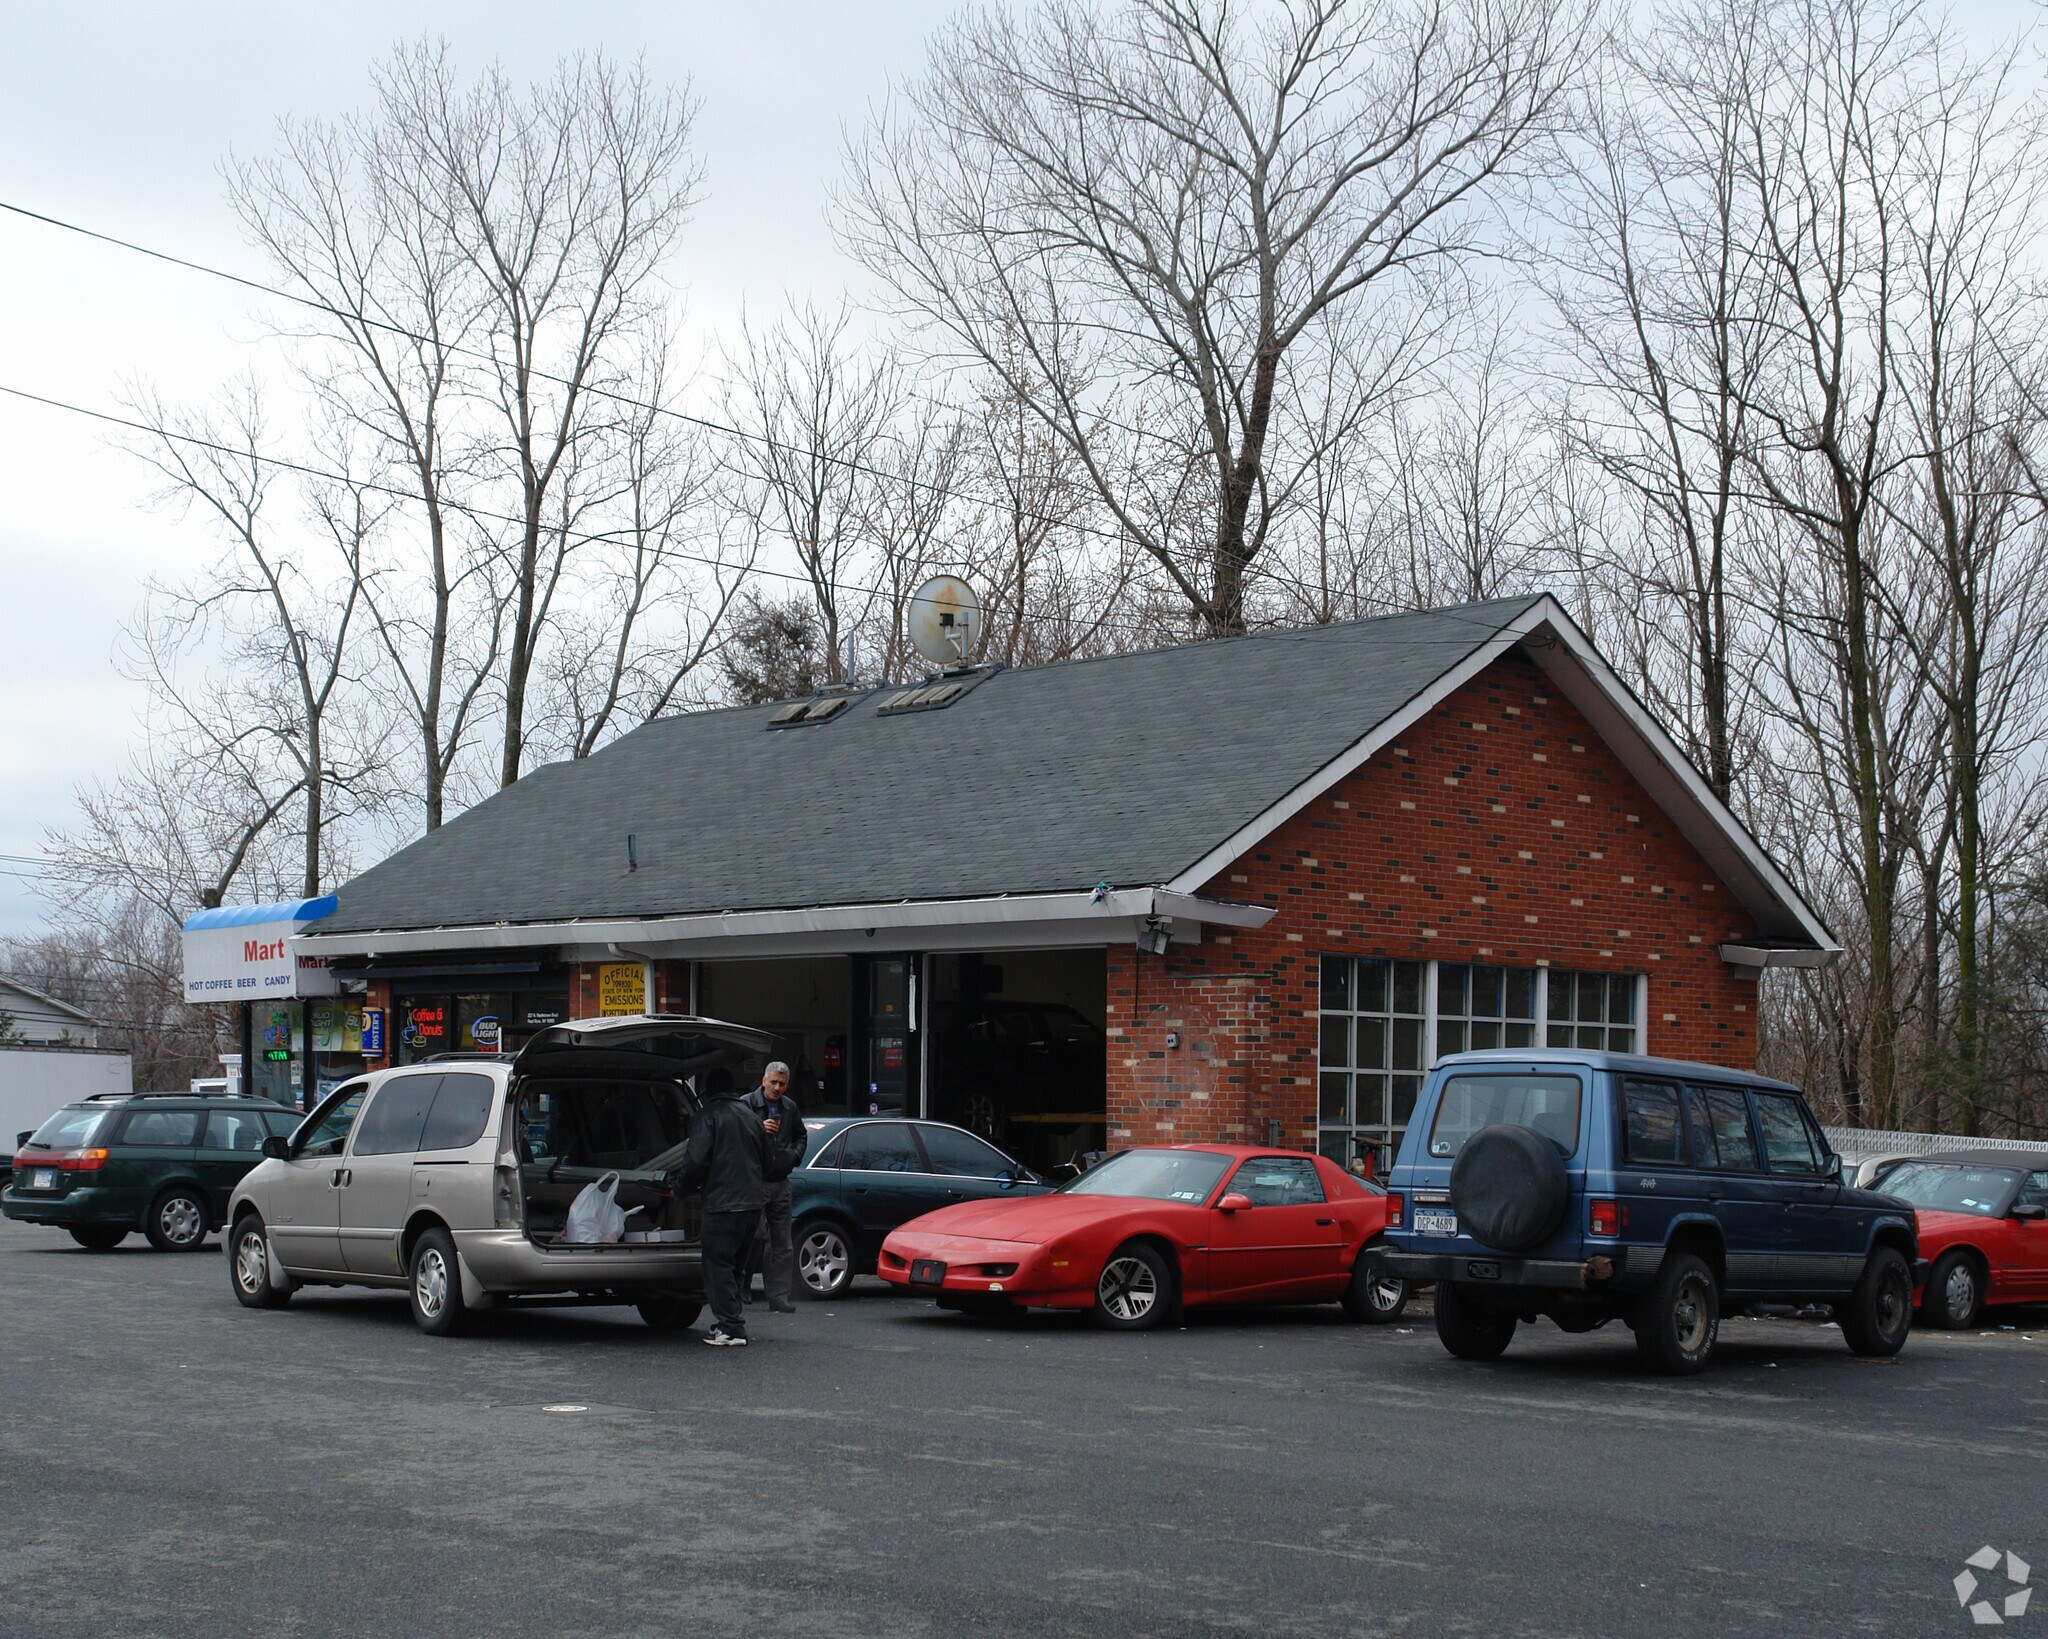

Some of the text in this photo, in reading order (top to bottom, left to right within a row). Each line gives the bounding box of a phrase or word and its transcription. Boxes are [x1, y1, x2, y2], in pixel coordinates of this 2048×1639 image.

[244, 938, 284, 962] Mart
[298, 956, 329, 968] Mart
[604, 967, 645, 985] OFFICIAL
[189, 975, 291, 991] HOT COFFEE BEER CANDY
[604, 995, 644, 1006] EMISSIONS
[412, 1008, 435, 1021] Coffee
[418, 1023, 443, 1036] Donuts
[478, 1022, 498, 1030] BUD
[475, 1030, 499, 1038] LIGHT
[268, 1051, 288, 1061] ATM
